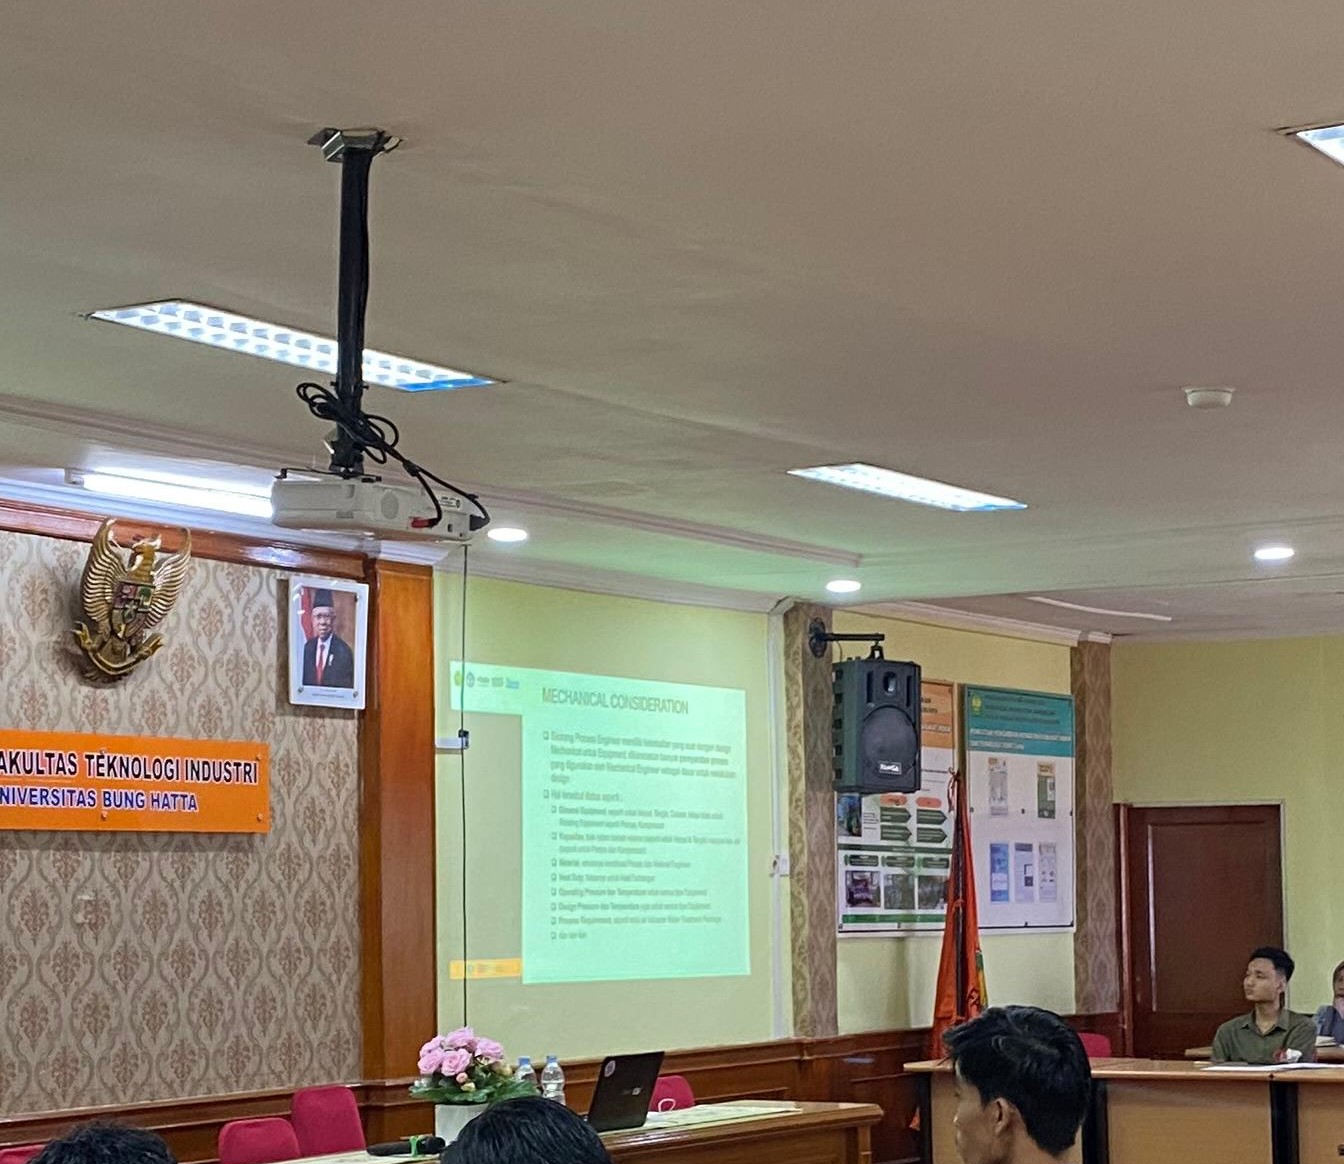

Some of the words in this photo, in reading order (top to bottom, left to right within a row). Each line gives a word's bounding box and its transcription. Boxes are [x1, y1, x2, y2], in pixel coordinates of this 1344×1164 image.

[542, 687, 609, 708] MECHANICAL
[613, 694, 689, 714] CONSIDERATION
[85, 752, 179, 782] TEKNOLOGI
[184, 760, 258, 785] INDUSTRI
[102, 790, 146, 810] BUNG
[150, 793, 199, 812] HATTA
